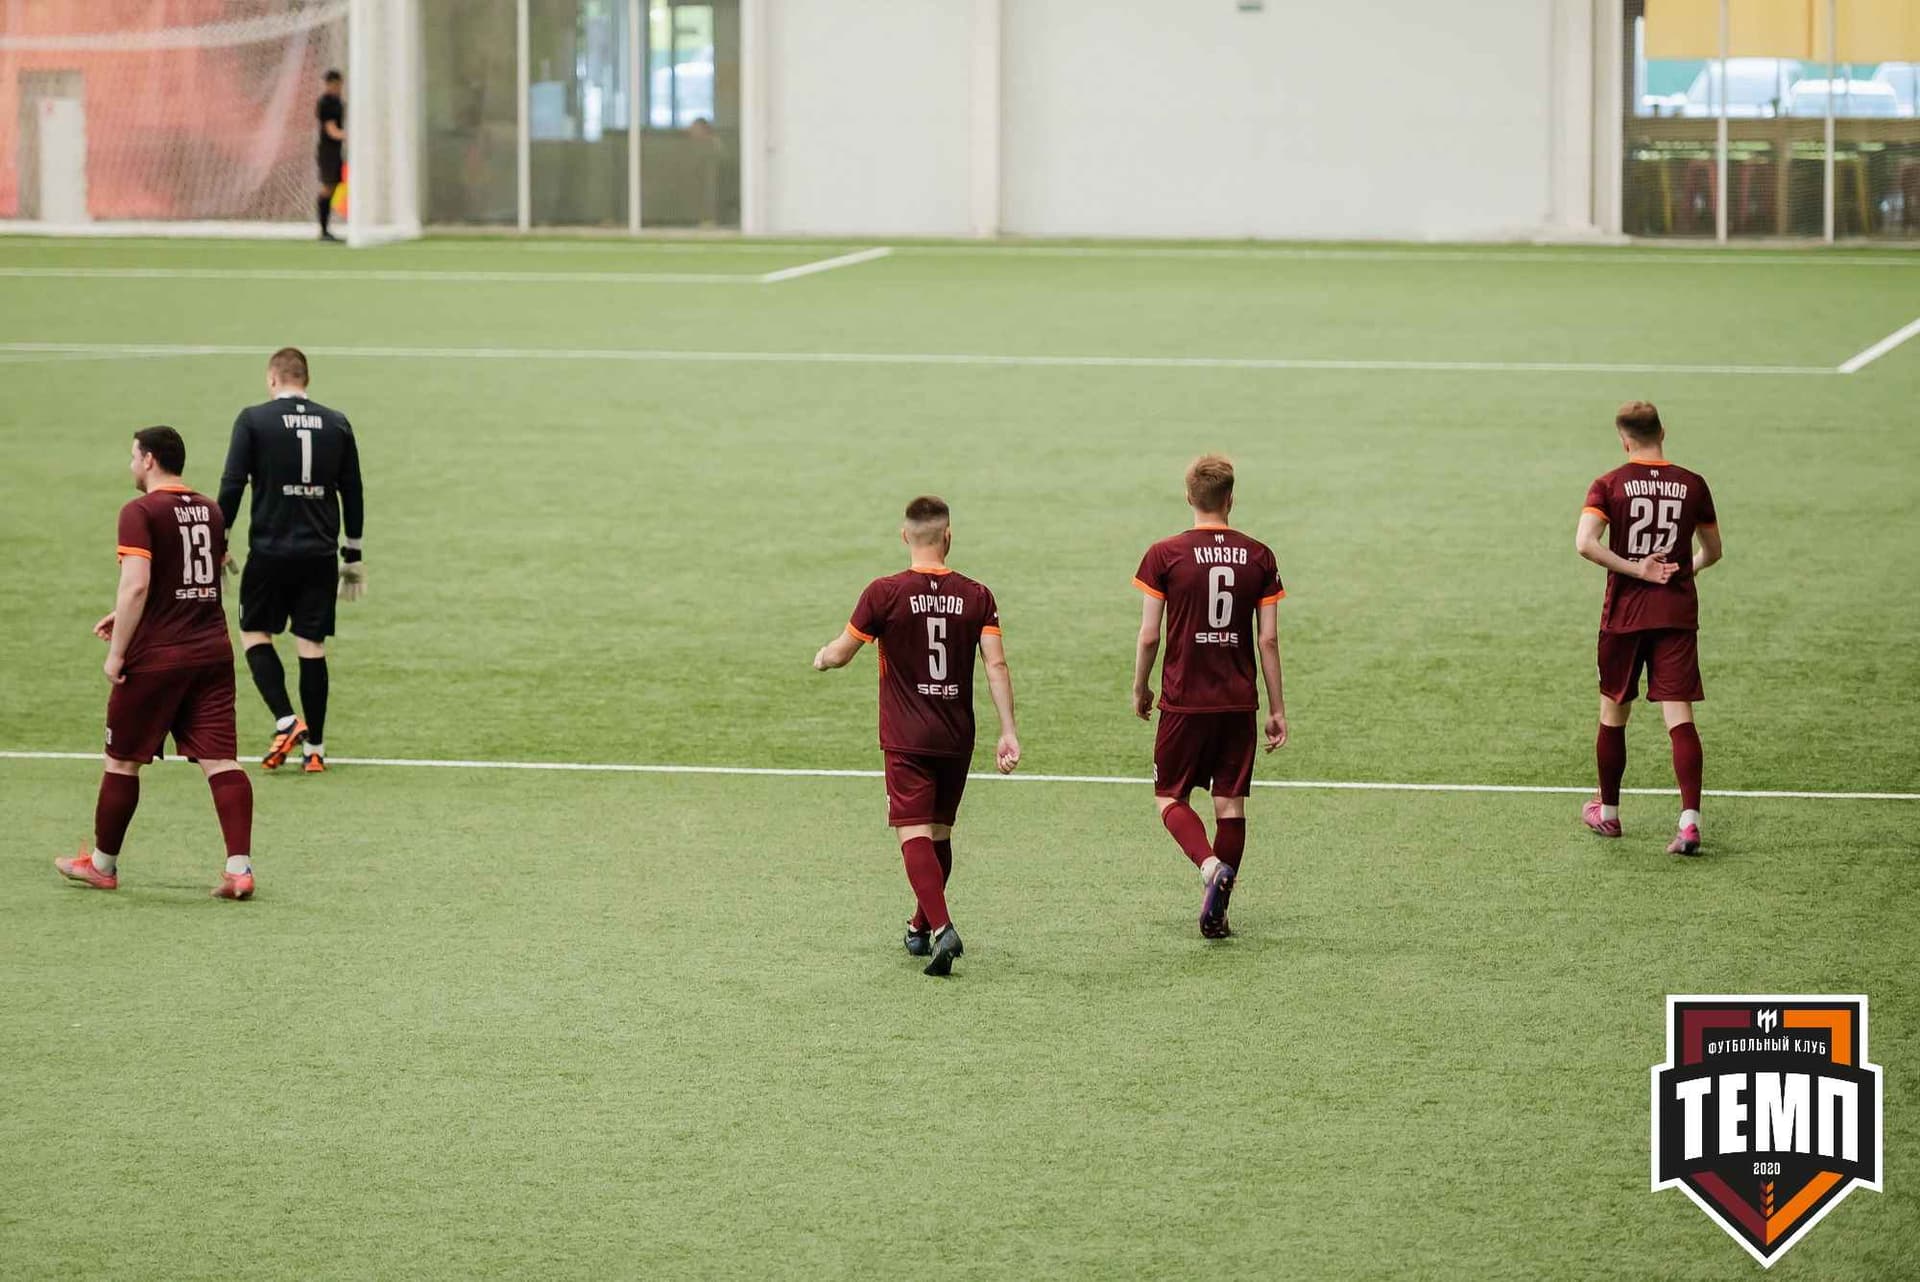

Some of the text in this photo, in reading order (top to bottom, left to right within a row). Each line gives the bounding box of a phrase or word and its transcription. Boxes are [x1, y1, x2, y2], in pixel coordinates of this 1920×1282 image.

[296, 429, 312, 483] 1
[283, 485, 325, 496] SEUS
[1624, 480, 1688, 499] НОВИЧКОВ
[174, 505, 210, 523] СЫЧЕВ
[1628, 497, 1682, 555] 25
[179, 524, 214, 585] 13
[1194, 547, 1248, 565] КНЯЗЕВ
[175, 587, 217, 600] SEUS
[1208, 566, 1235, 629] 6
[1195, 631, 1239, 644] SEUS
[926, 617, 947, 681] 5
